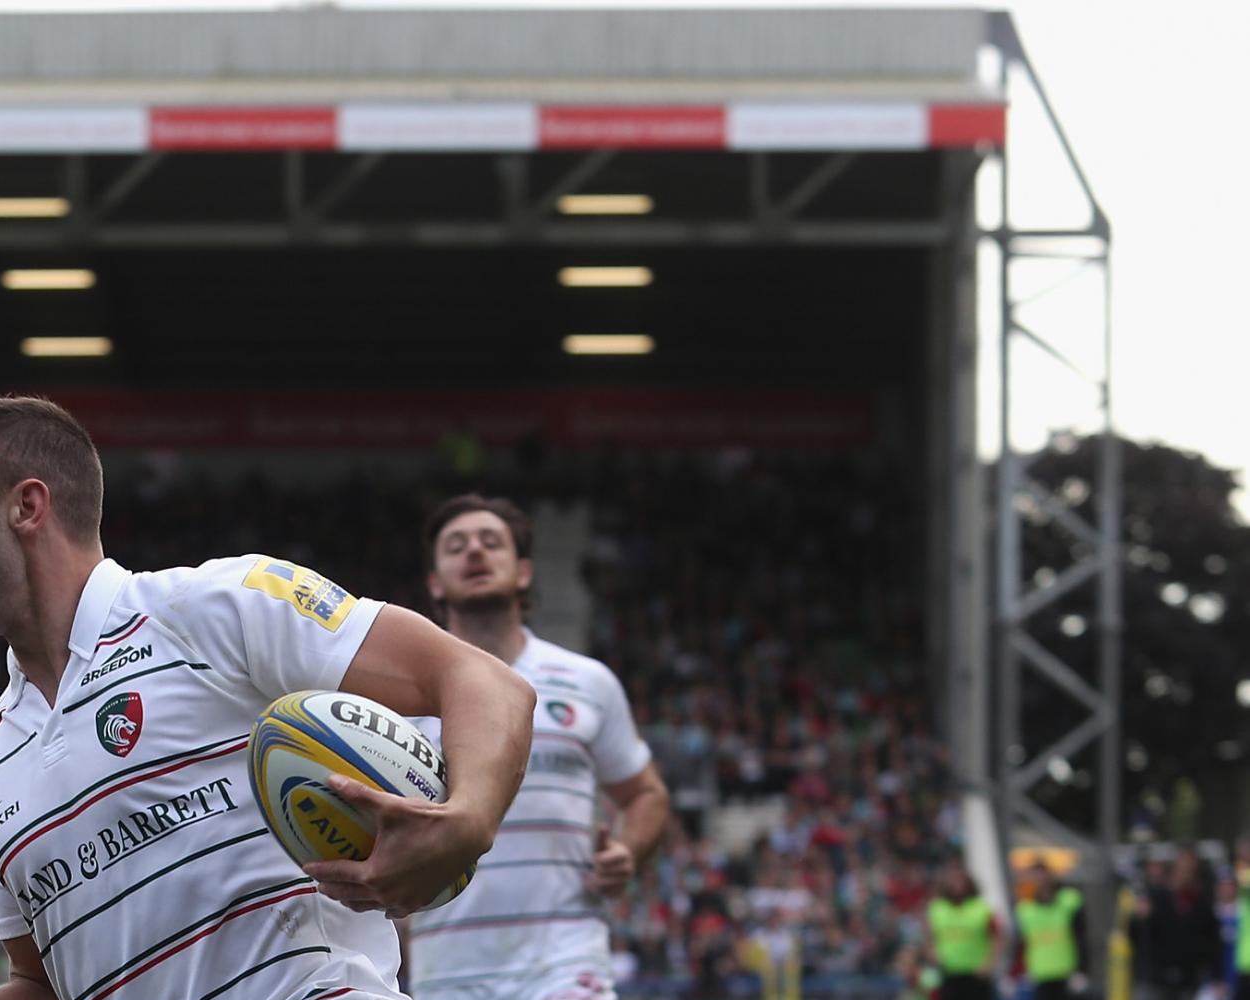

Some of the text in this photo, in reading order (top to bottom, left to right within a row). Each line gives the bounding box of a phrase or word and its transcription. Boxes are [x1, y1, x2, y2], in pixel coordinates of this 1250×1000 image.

[80, 644, 153, 687] BREEDON
[405, 769, 437, 802] RUGBY
[77, 840, 100, 880] &
[97, 777, 239, 861] BARRETT
